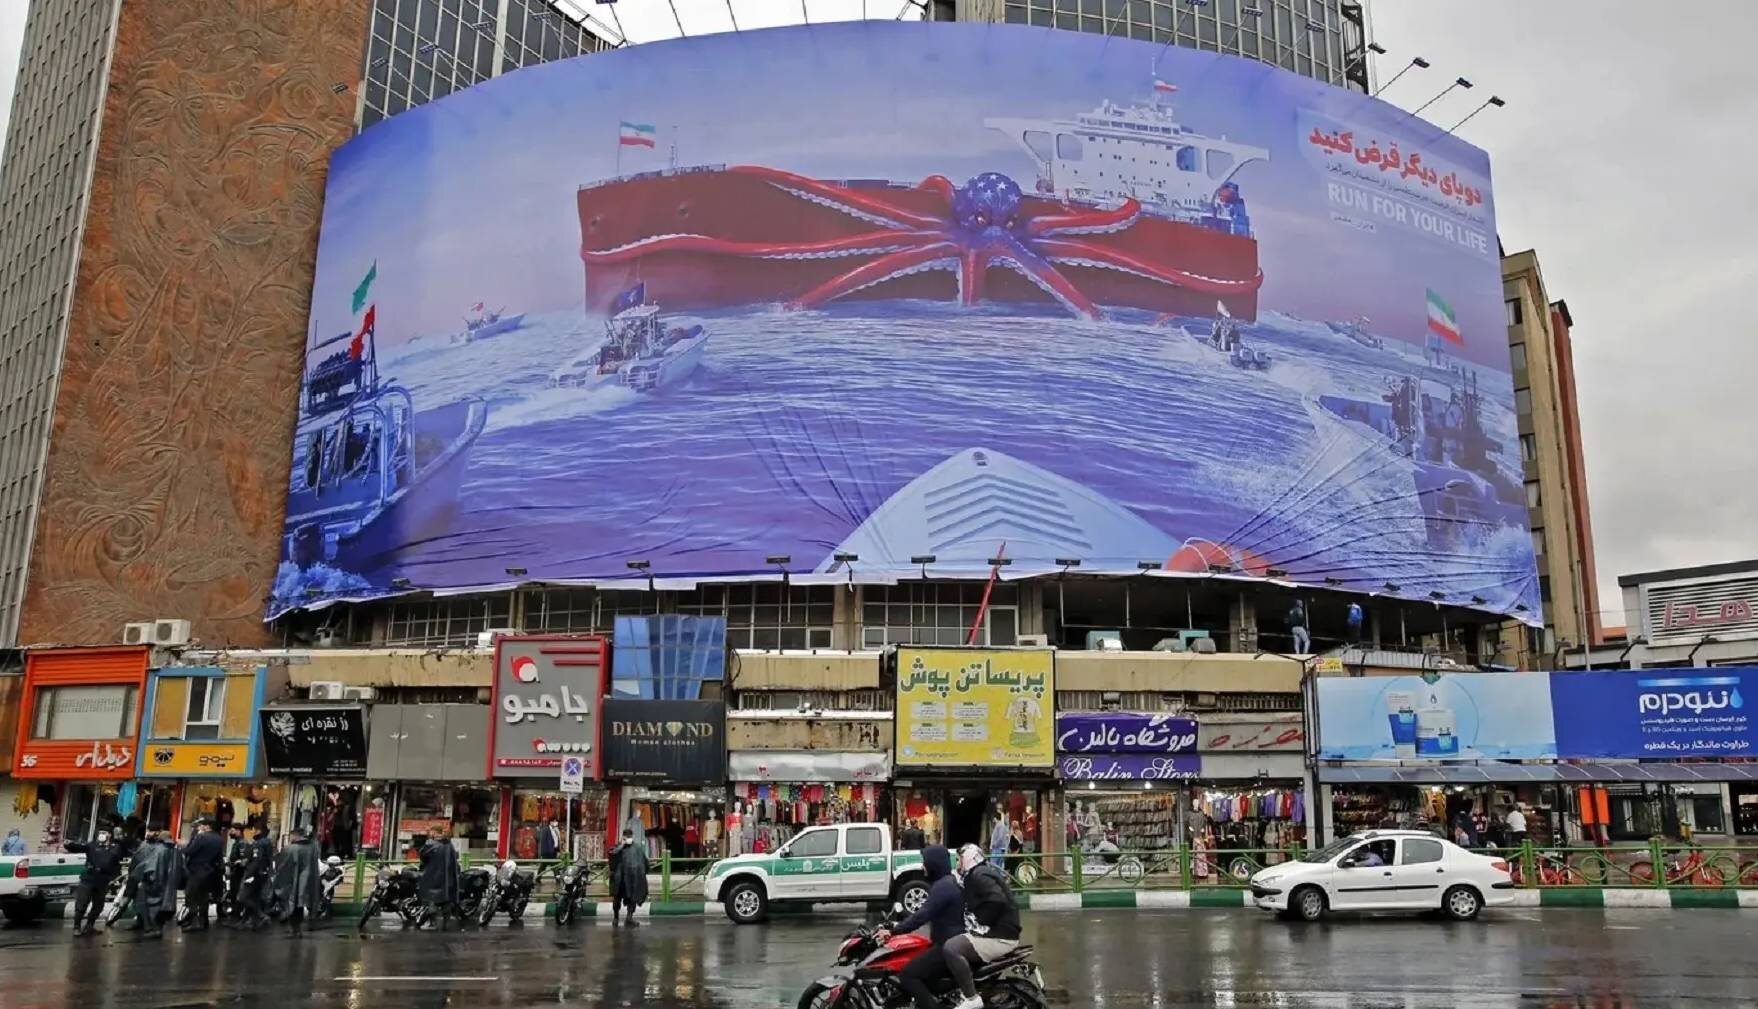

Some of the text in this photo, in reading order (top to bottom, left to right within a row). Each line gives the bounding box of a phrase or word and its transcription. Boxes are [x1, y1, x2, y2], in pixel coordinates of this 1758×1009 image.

[1309, 128, 1353, 154] کنید
[1355, 140, 1400, 171] قرض
[1400, 153, 1437, 187] دیگر
[1328, 182, 1368, 211] RUN
[1373, 198, 1407, 224] FOR
[1410, 209, 1454, 242] YOUR
[1456, 226, 1488, 254] LIFE
[900, 656, 1045, 699] پریسا تن پوش
[503, 685, 588, 723] بامبو
[317, 717, 337, 731] نقره
[1123, 714, 1196, 752] فروشگاه
[1643, 740, 1750, 751] طراوت ماندگار در یک قطره
[841, 858, 870, 871] پلیس
